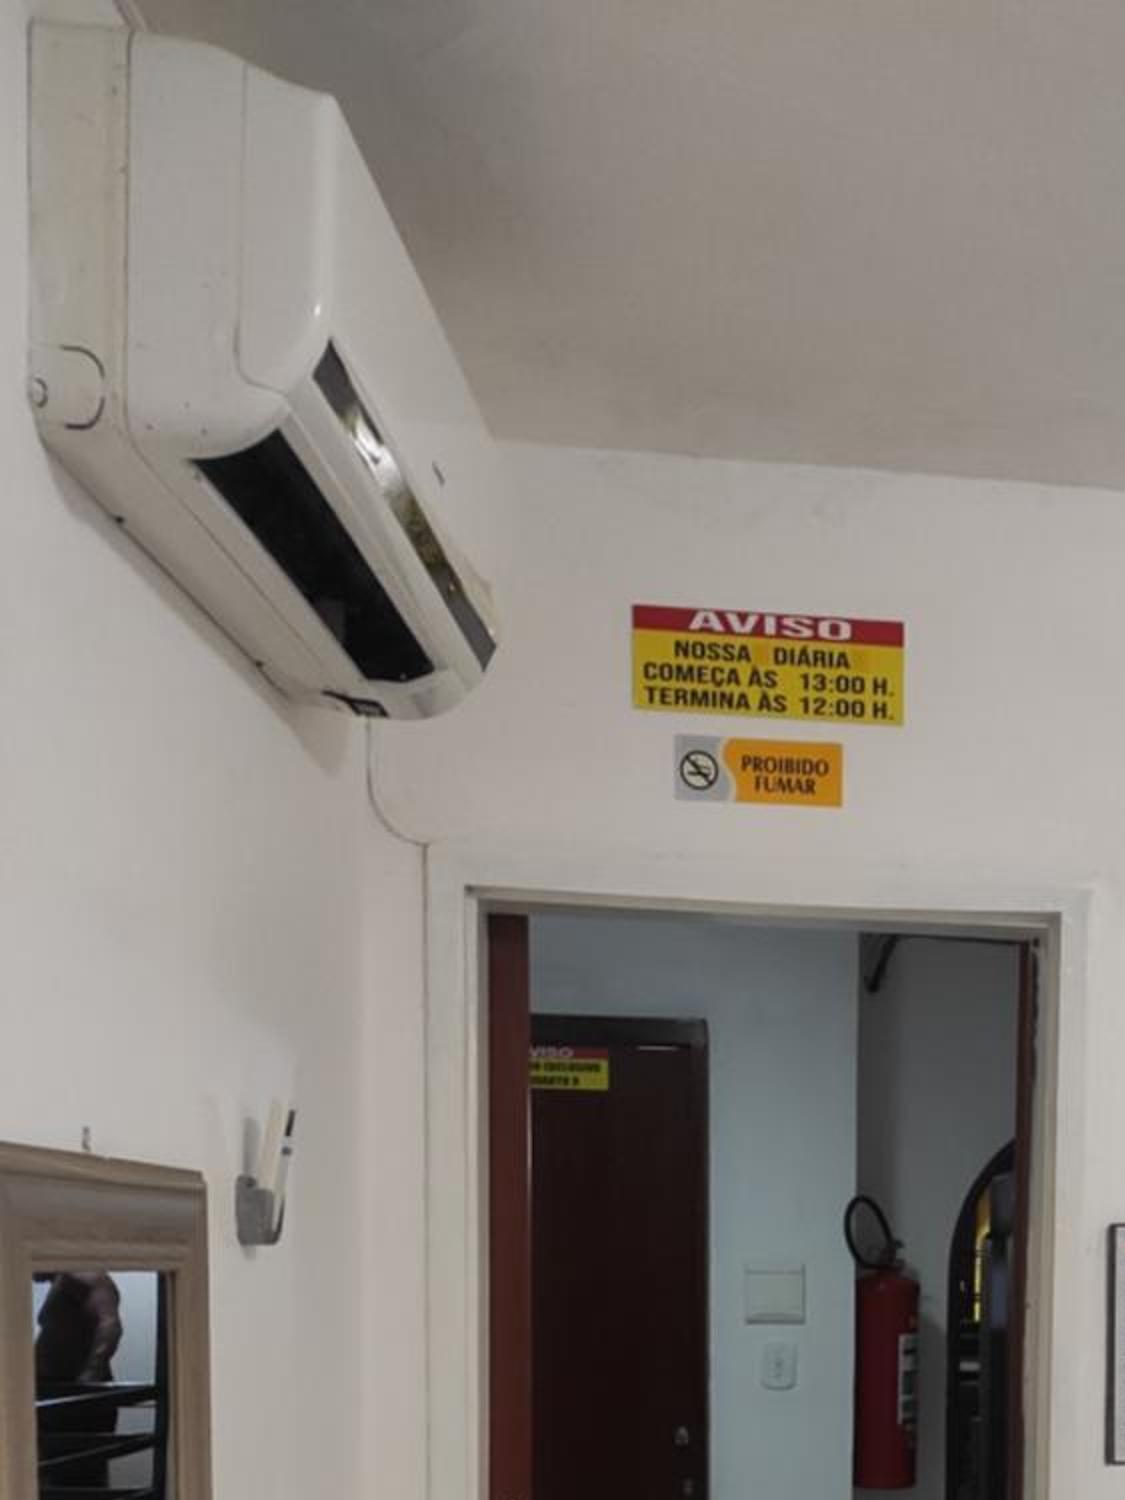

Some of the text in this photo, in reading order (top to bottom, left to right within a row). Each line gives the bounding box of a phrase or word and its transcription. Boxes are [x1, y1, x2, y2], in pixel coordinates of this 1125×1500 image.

[690, 611, 852, 641] AVISO
[674, 640, 850, 669] NOSSA DIÁRIA
[643, 661, 895, 697] COMEÇA ÀS 13:00 H.
[644, 686, 895, 720] TERMINA ÀS 12:00 H.
[741, 754, 829, 777] PROIBIDO
[755, 776, 816, 795] FUMAR
